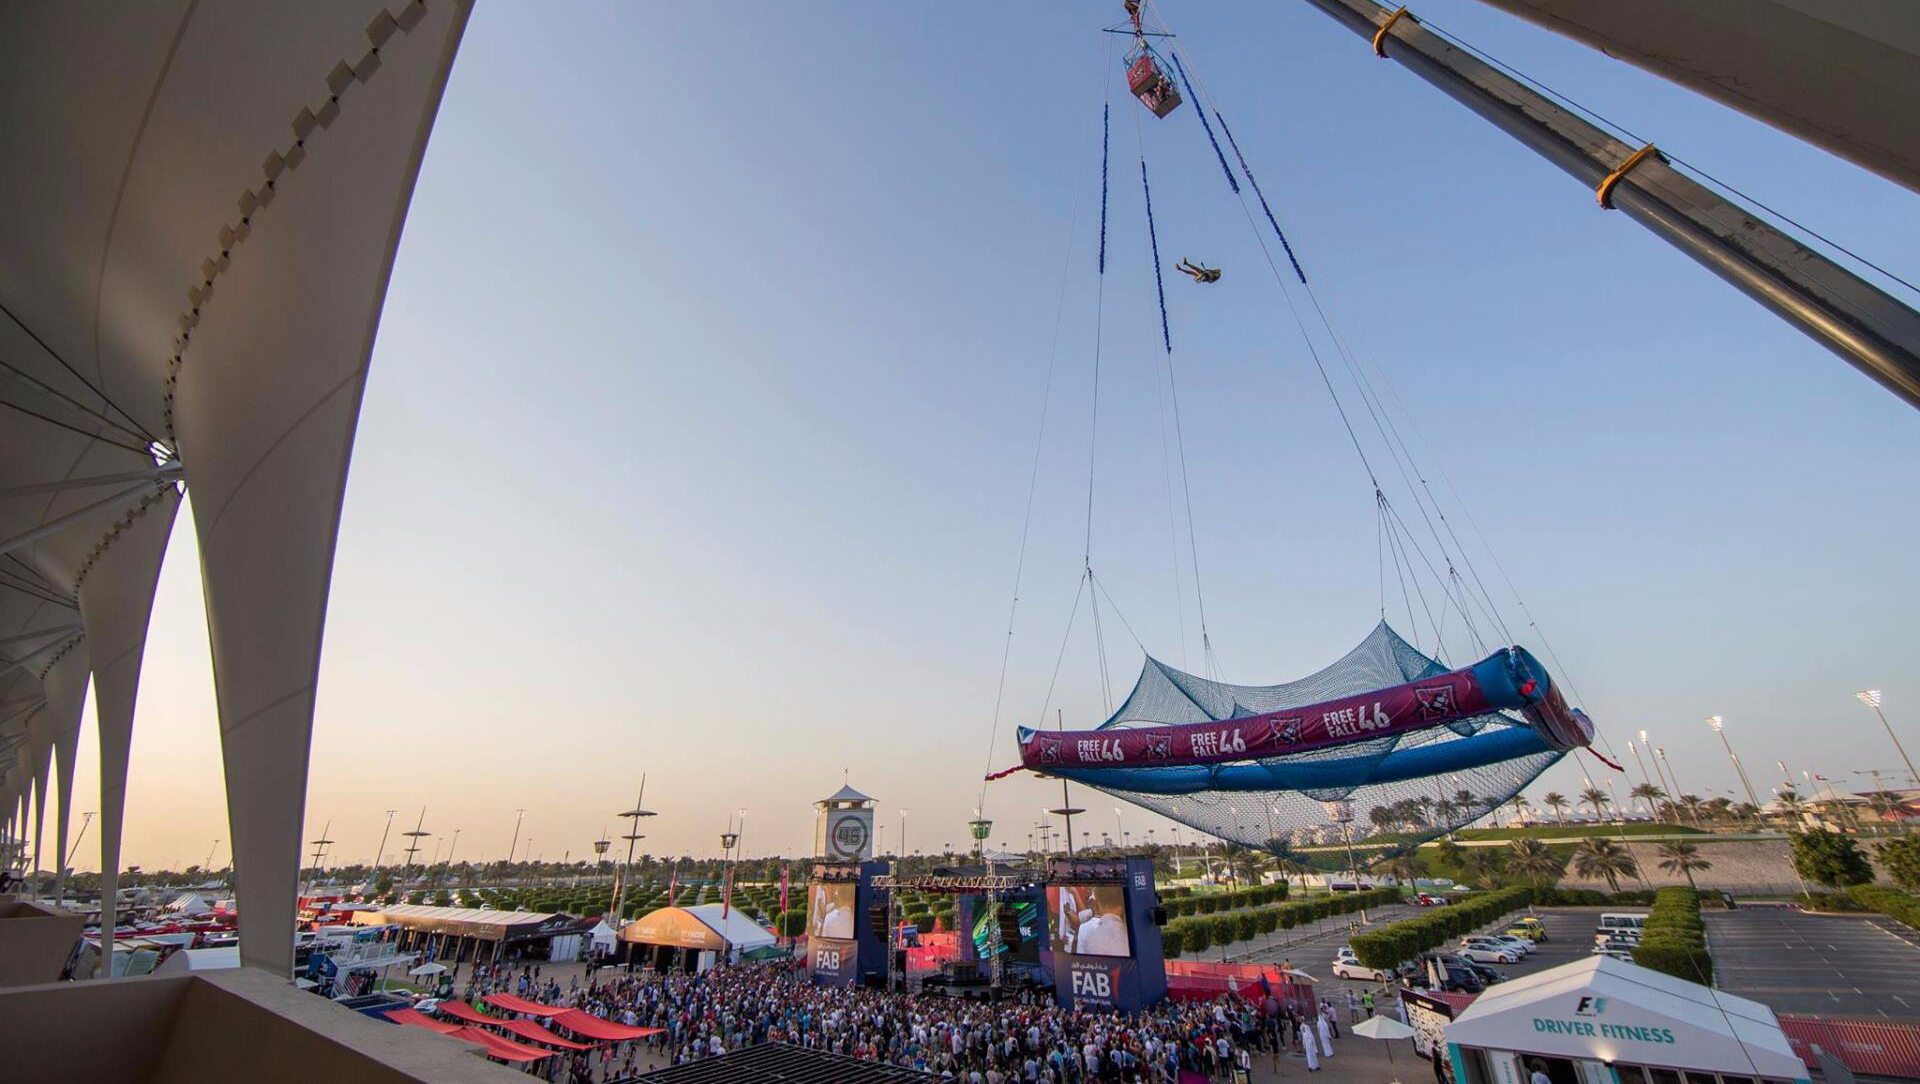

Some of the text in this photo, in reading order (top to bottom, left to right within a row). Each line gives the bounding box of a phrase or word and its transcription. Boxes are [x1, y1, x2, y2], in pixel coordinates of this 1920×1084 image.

[1323, 708, 1356, 725] FREE
[1358, 702, 1391, 730] 46
[1326, 722, 1361, 738] FALL
[1078, 740, 1100, 752] FREE
[1191, 732, 1217, 746] FREE
[1219, 729, 1246, 754] 46
[1079, 750, 1103, 762] FALL
[1101, 739, 1125, 762] 46
[1193, 745, 1221, 757] FALL
[1135, 875, 1146, 887] FAB
[816, 950, 840, 970] FAB
[1072, 971, 1111, 997] FAB
[1533, 1018, 1675, 1044] DRIVER FITNESS
